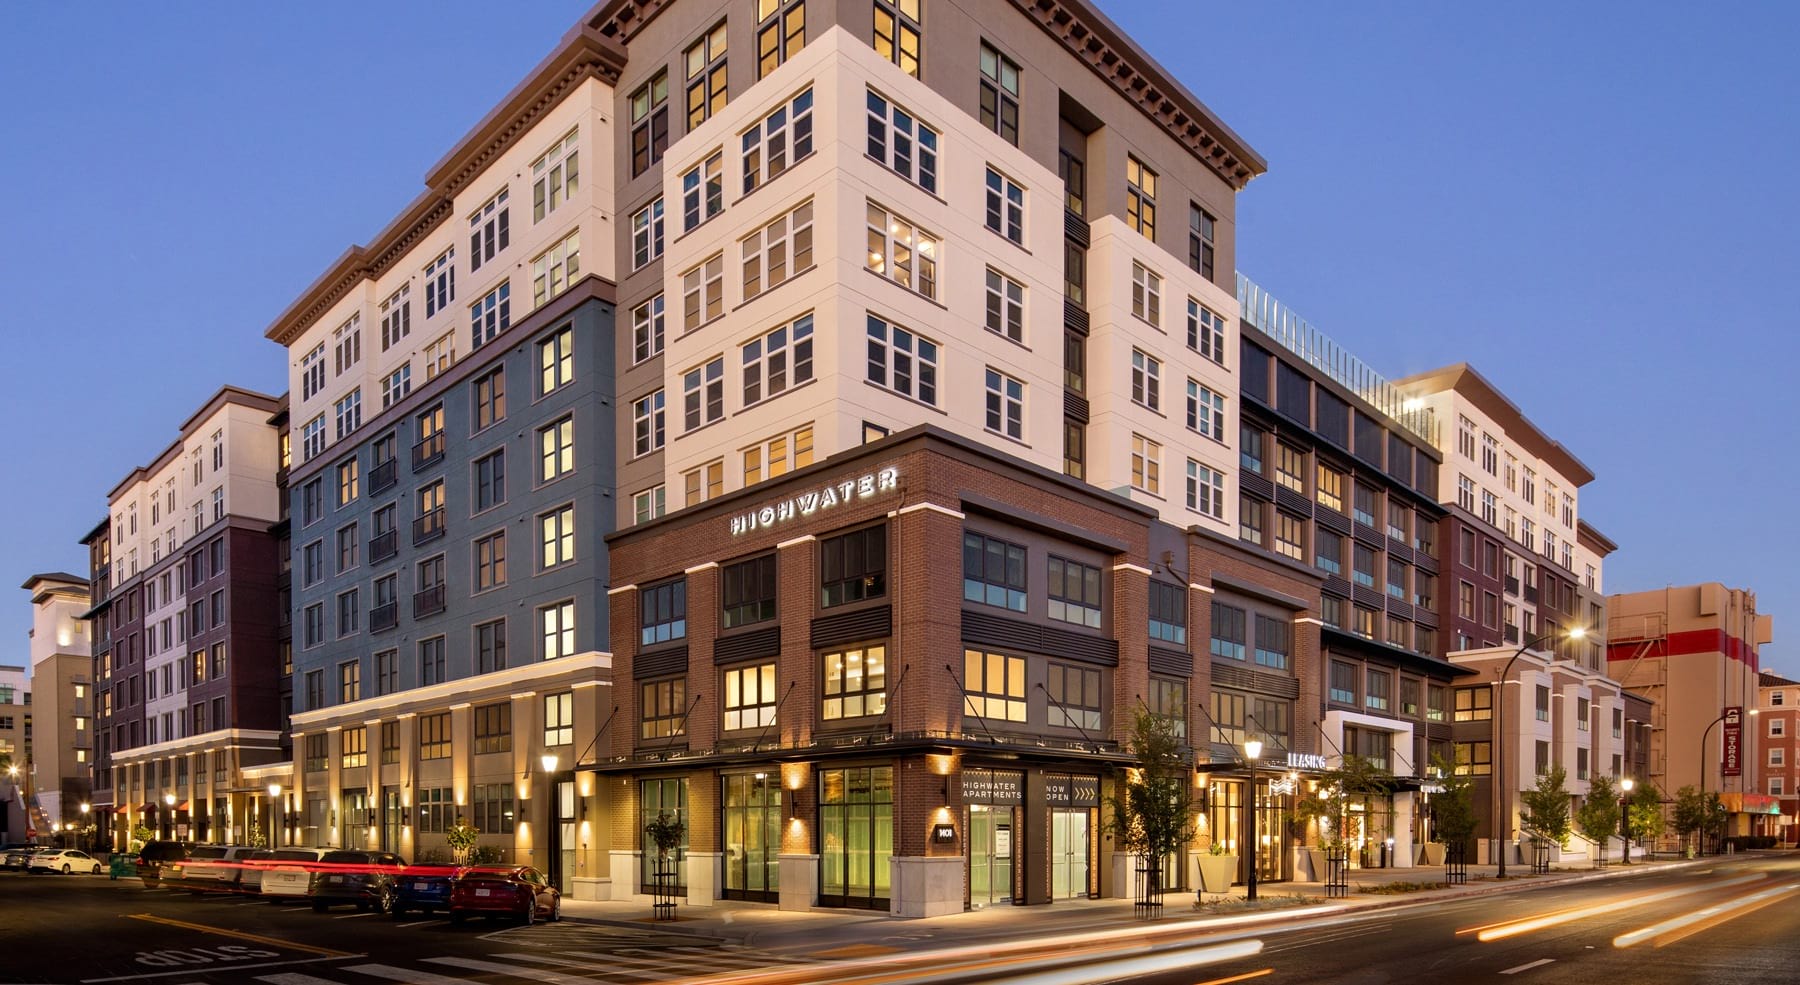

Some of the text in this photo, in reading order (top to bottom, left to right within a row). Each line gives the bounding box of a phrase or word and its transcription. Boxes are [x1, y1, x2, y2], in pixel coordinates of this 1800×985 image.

[731, 468, 897, 534] HIGHWATER
[1288, 752, 1326, 768] LEASING
[1728, 735, 1736, 768] STORAGE
[963, 782, 1016, 790] HIGHWATER
[963, 791, 1022, 799] APARTMENTS
[135, 945, 280, 966] STOP
